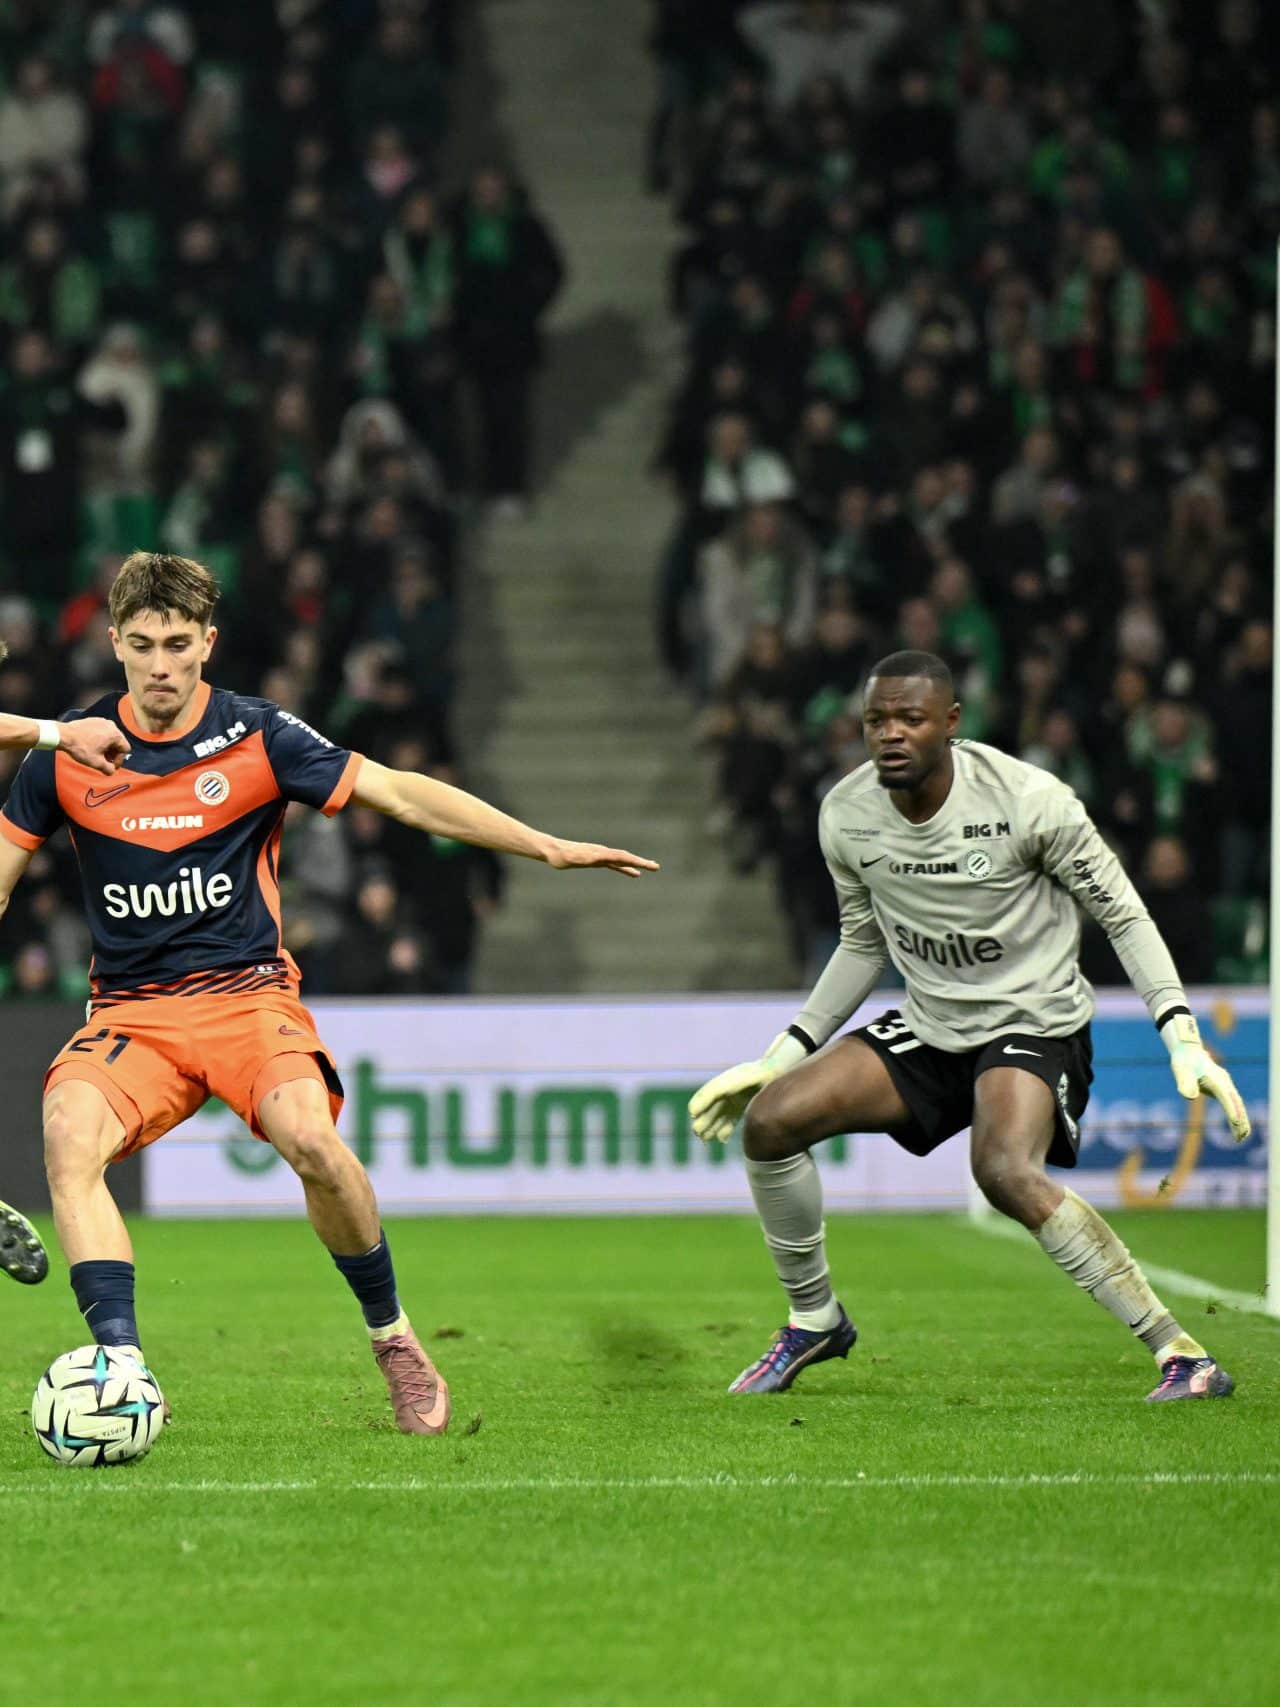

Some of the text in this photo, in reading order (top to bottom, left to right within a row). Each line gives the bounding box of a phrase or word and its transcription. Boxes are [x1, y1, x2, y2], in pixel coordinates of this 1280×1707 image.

[193, 721, 246, 758] BIG M
[139, 815, 203, 830] FAUN
[963, 822, 1011, 839] BIG M
[903, 863, 958, 875] FAUN
[103, 867, 233, 919] swile
[894, 925, 1005, 968] swile
[68, 1028, 131, 1065] 21
[866, 1018, 921, 1054] 31
[353, 1058, 847, 1167] humm
